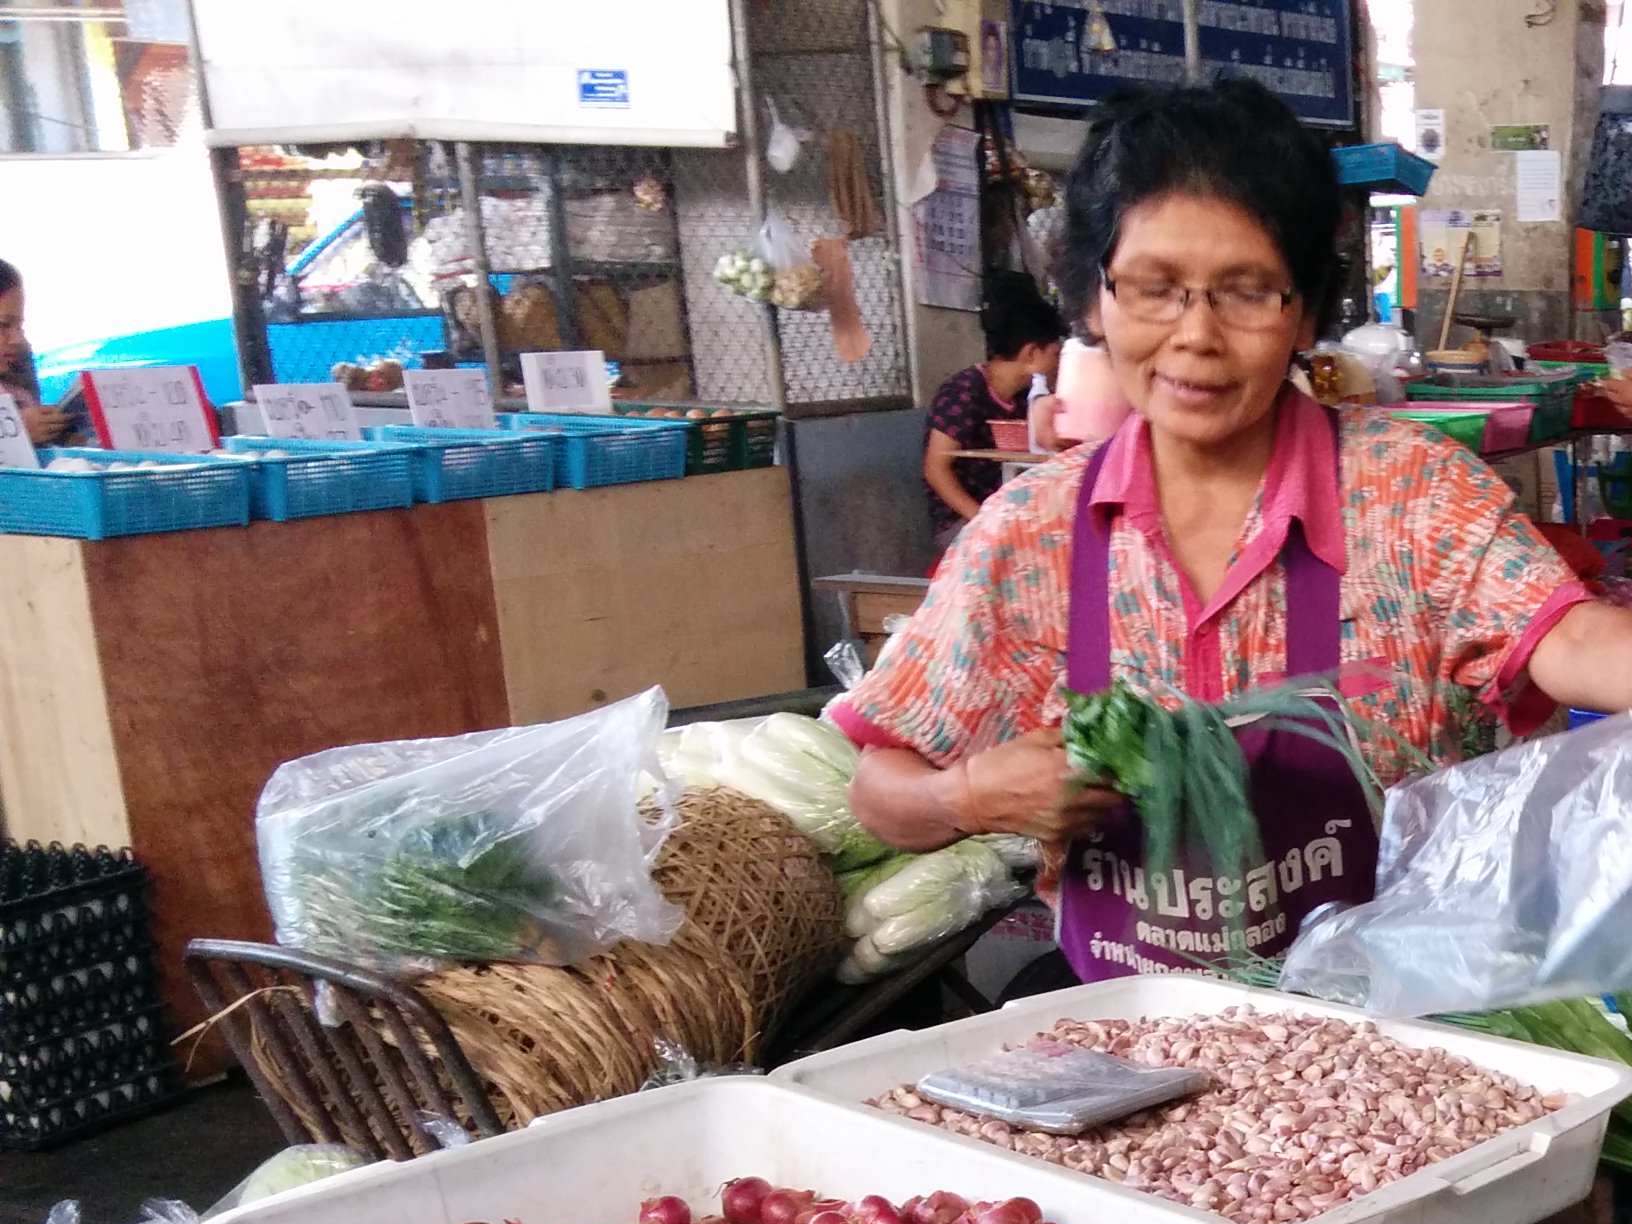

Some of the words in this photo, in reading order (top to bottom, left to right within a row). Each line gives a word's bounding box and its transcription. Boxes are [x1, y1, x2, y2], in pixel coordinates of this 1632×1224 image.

[1082, 819, 1352, 921] ร้านประสงค์
[1136, 911, 1286, 953] ตลาดแม่กลอง
